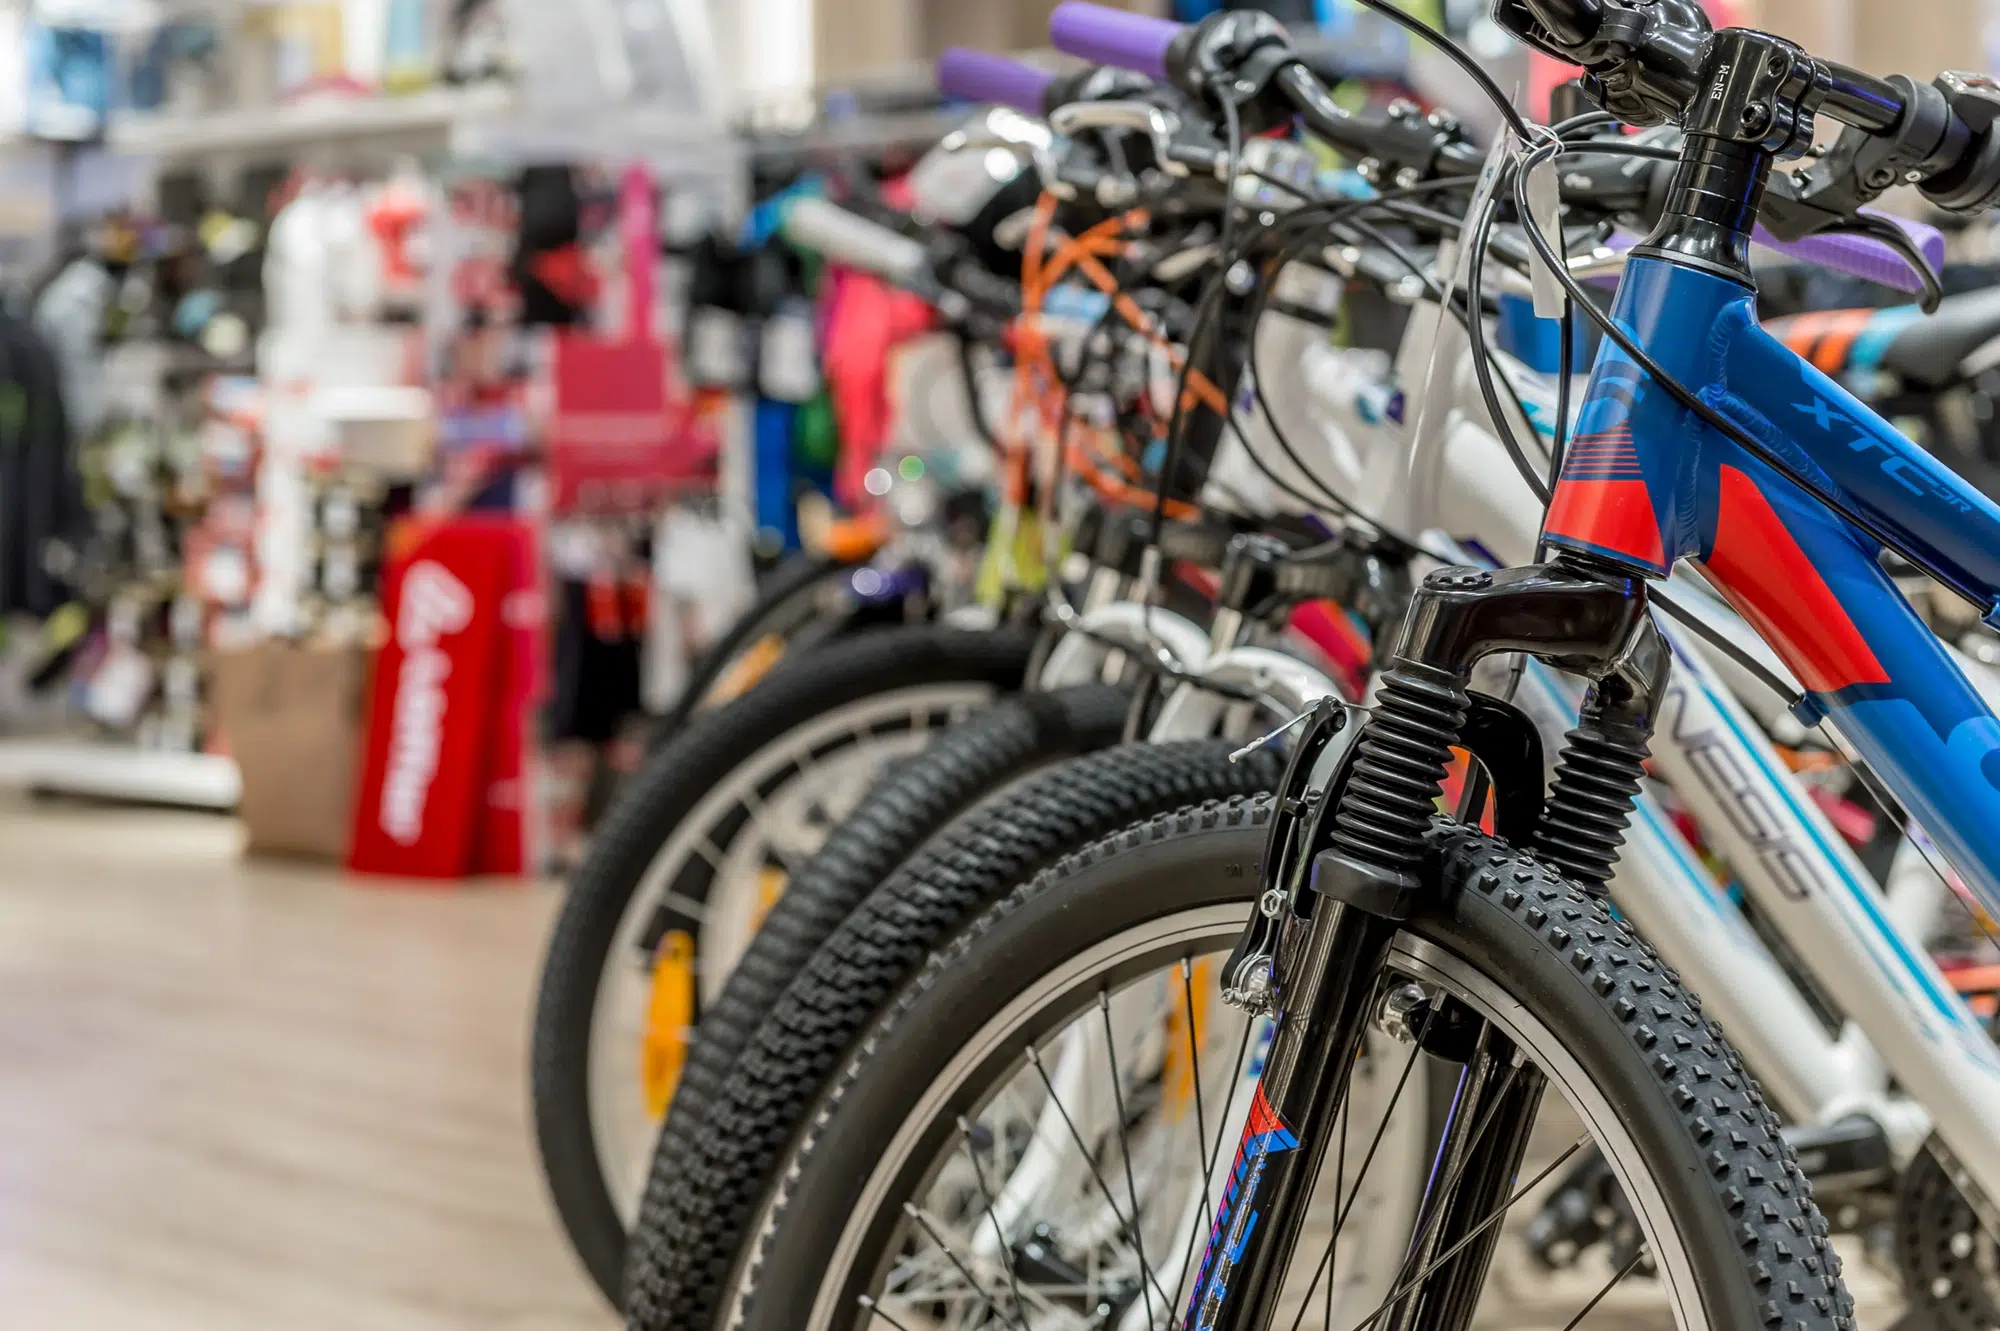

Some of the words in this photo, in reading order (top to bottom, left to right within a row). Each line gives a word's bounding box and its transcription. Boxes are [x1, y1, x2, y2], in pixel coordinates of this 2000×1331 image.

[1711, 64, 1730, 100] EN-M
[1790, 395, 1941, 497] XTC
[1666, 685, 1829, 903] NESIS
